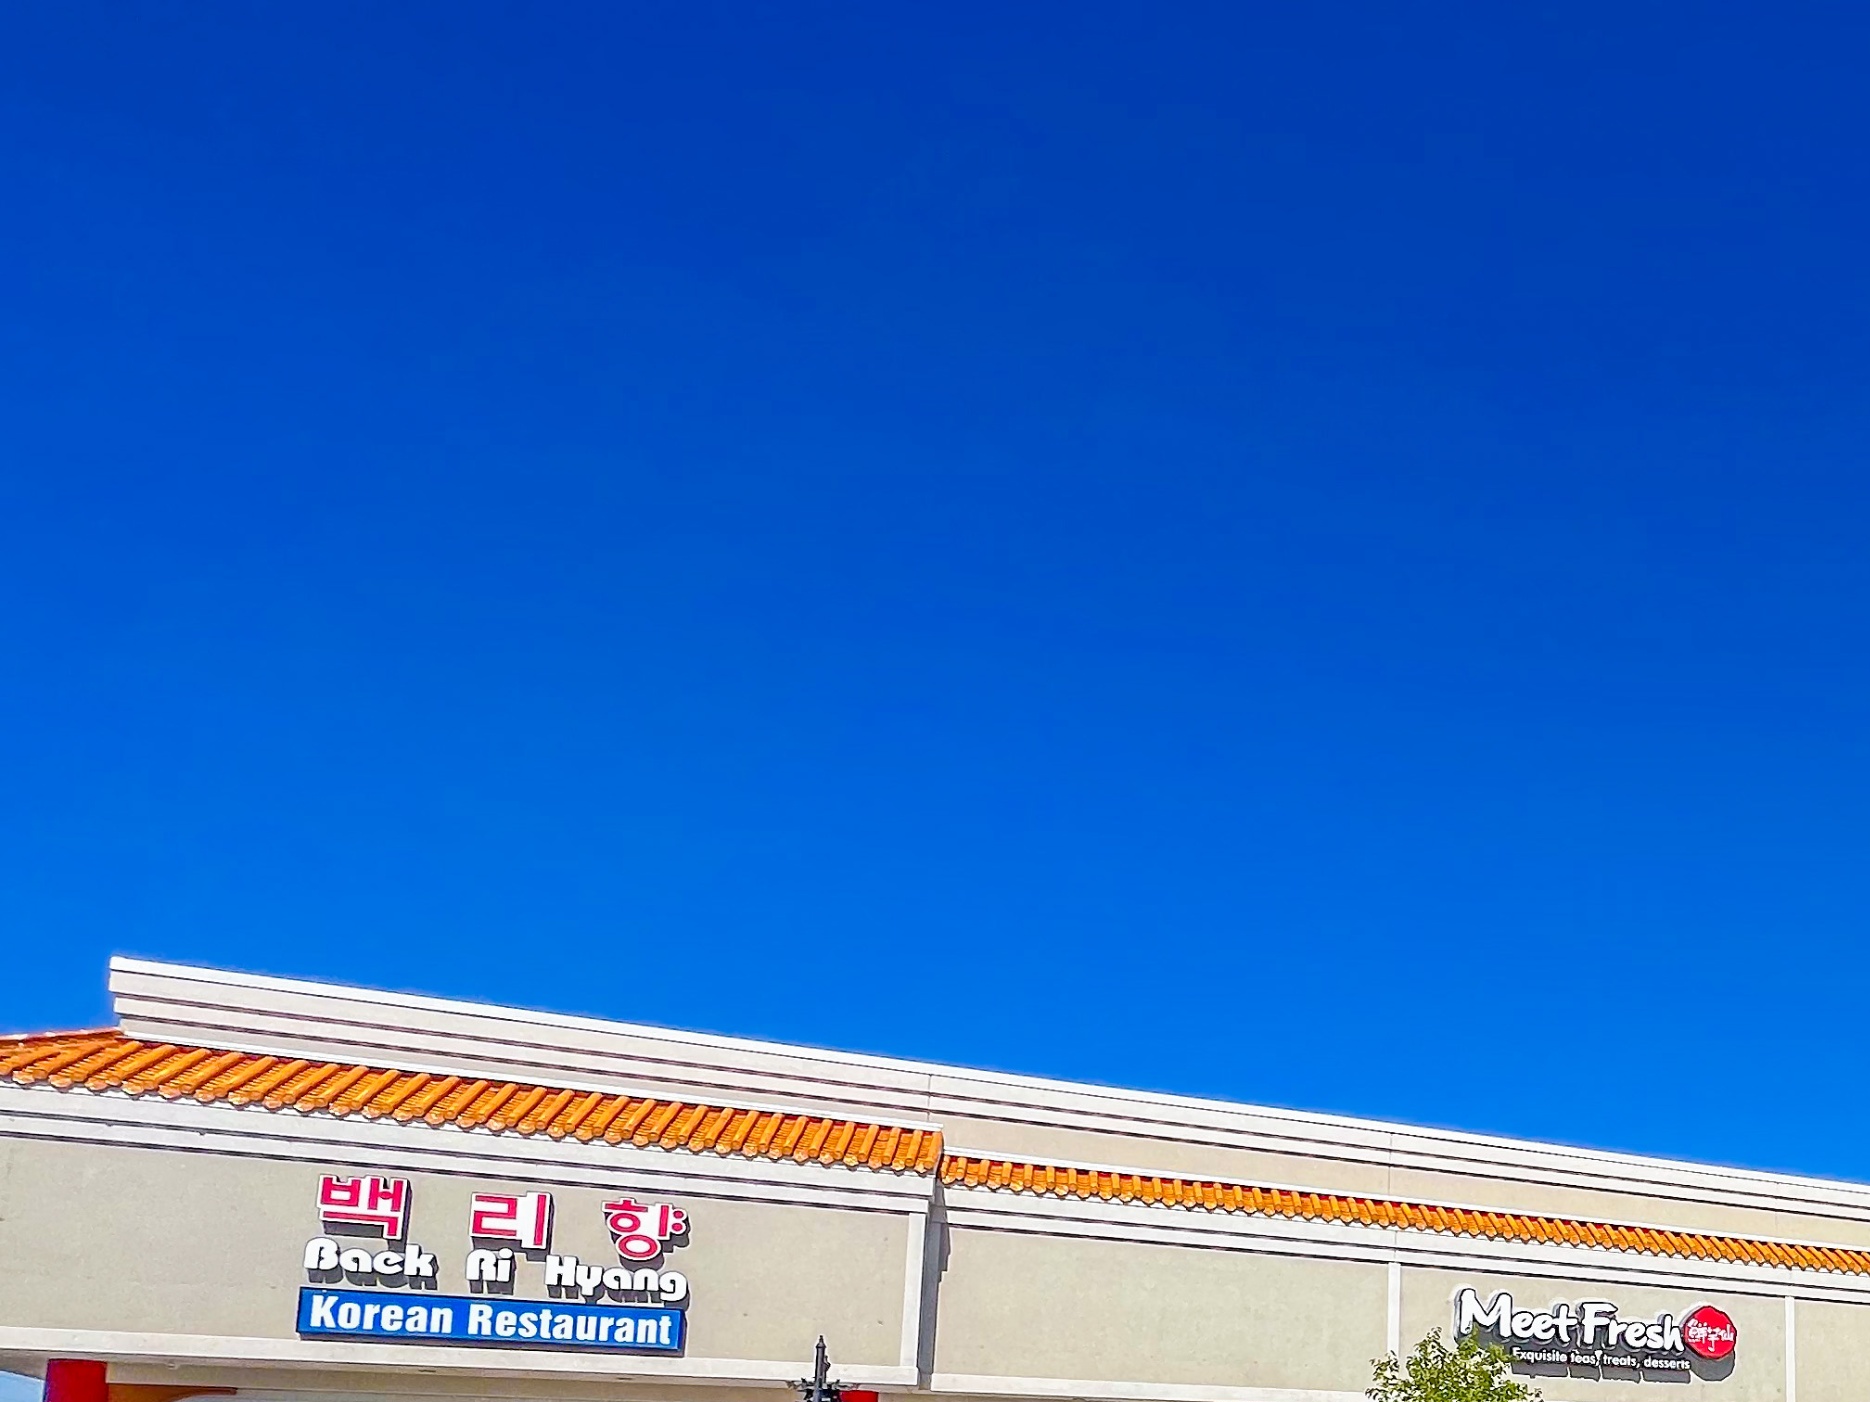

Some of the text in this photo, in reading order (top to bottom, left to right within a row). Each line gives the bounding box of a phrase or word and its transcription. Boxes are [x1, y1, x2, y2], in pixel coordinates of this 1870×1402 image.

[316, 1173, 688, 1261] 백 리 향
[303, 1237, 688, 1302] Baek Ri Hyang
[310, 1295, 673, 1345] Korean Restaurant
[1460, 1288, 1685, 1352] Meet Fresh
[1512, 1347, 1568, 1365] Exquisite
[1603, 1353, 1641, 1369] treats,
[1644, 1356, 1691, 1370] desserts
